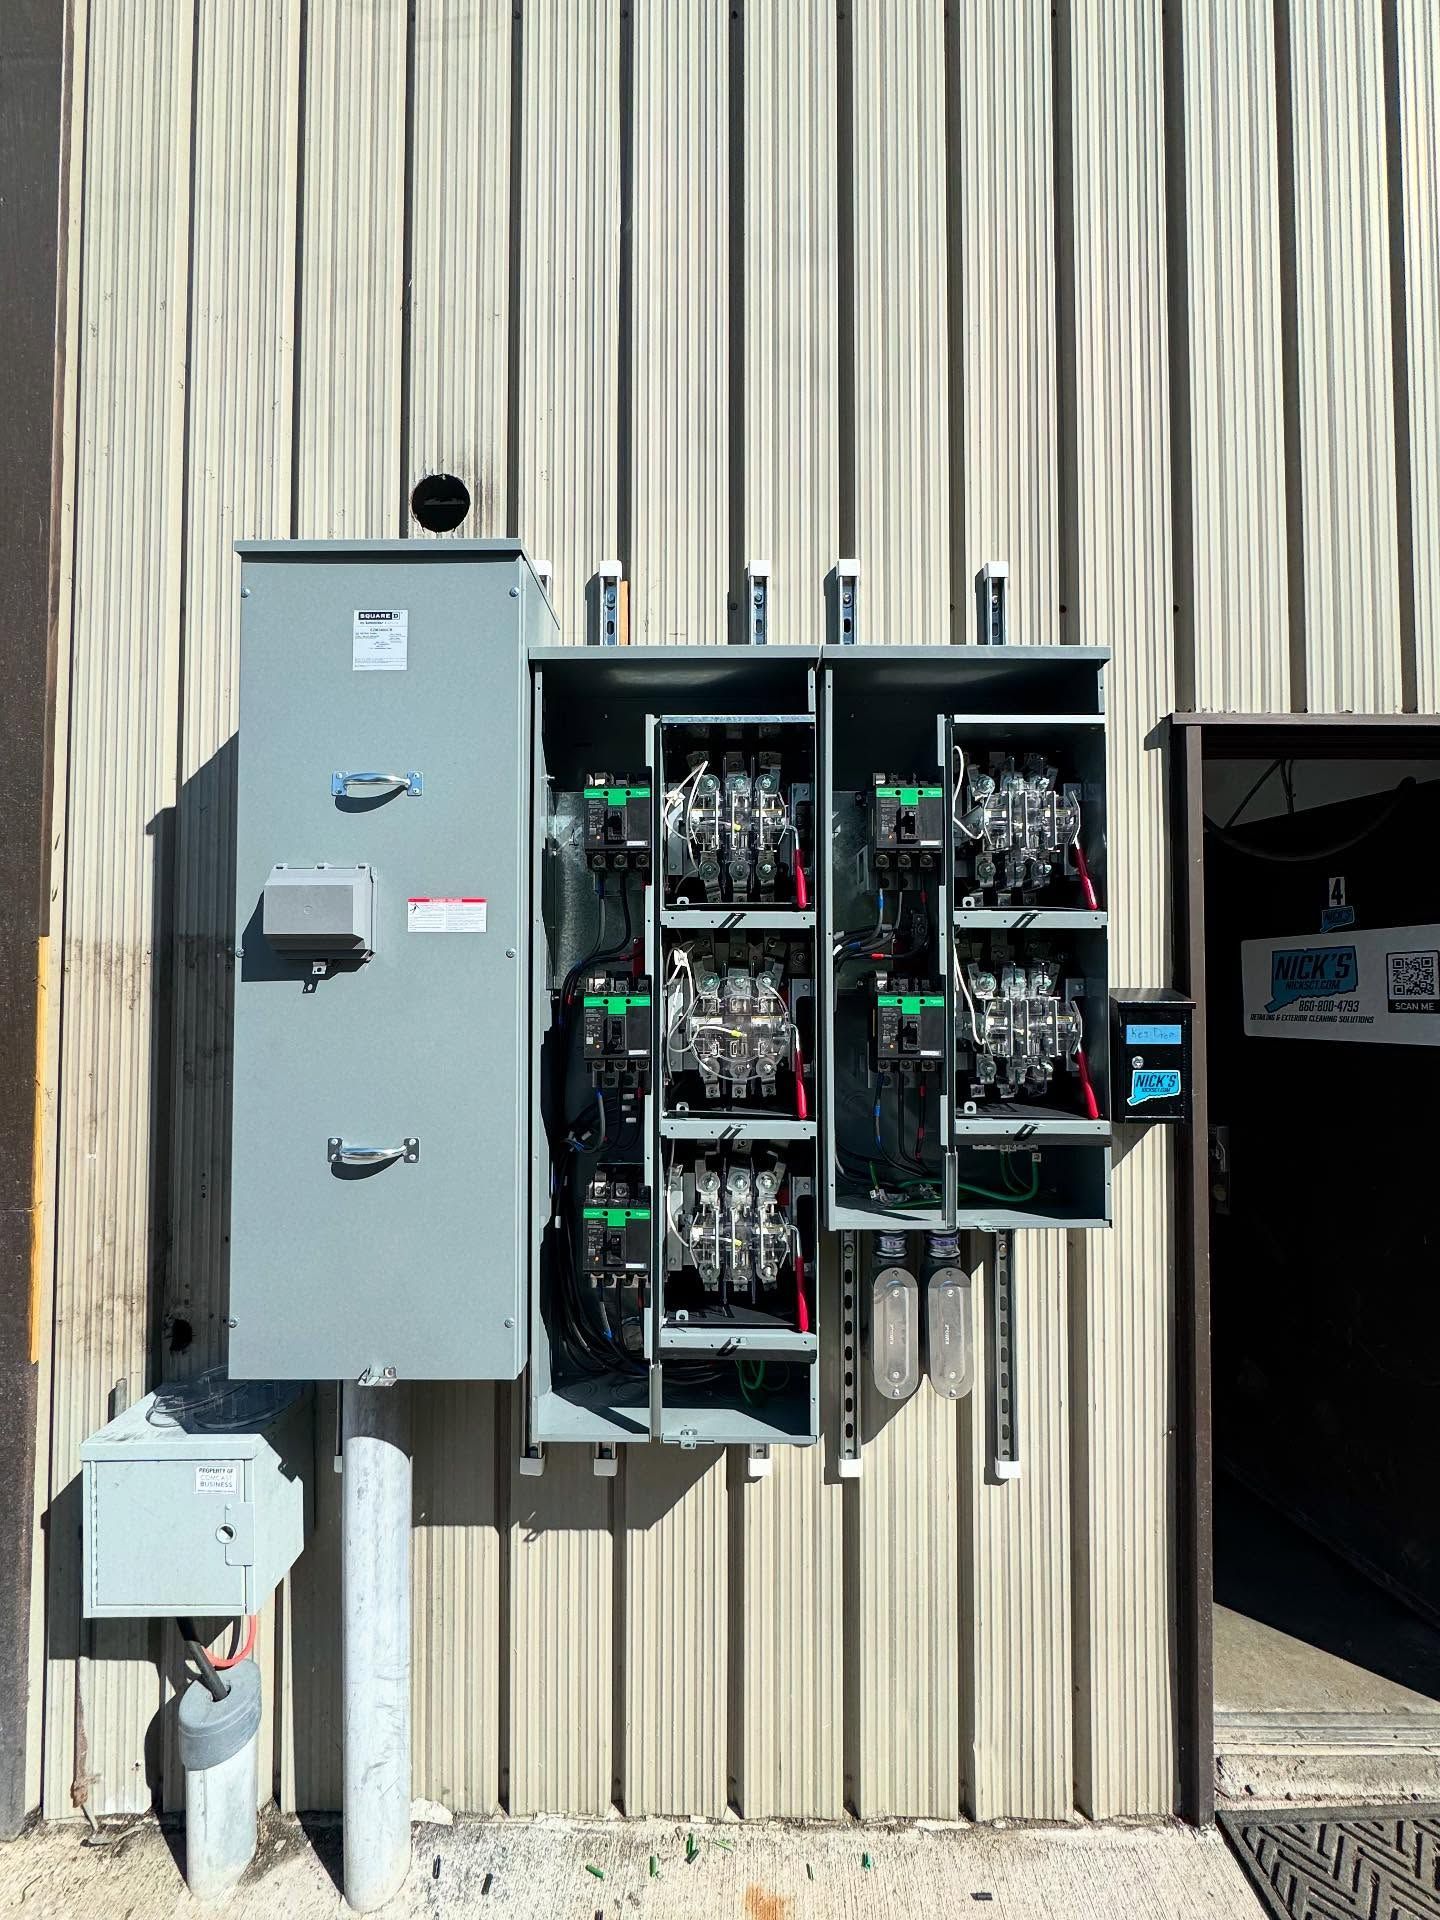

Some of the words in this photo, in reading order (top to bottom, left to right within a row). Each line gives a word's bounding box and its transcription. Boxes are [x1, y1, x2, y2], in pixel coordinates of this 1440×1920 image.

[1331, 878, 1344, 905] 4
[1275, 953, 1353, 980] NICK'S
[1285, 980, 1340, 990] NICKSCT.COM
[1299, 1000, 1359, 1012] 860-800-4793
[1395, 1002, 1419, 1010] SCAN
[1281, 1014, 1308, 1022] EXTERIOR
[1309, 1014, 1338, 1023] CLEANING
[1338, 1015, 1375, 1024] SOLUTIONS
[1135, 1074, 1177, 1087] NICK'S
